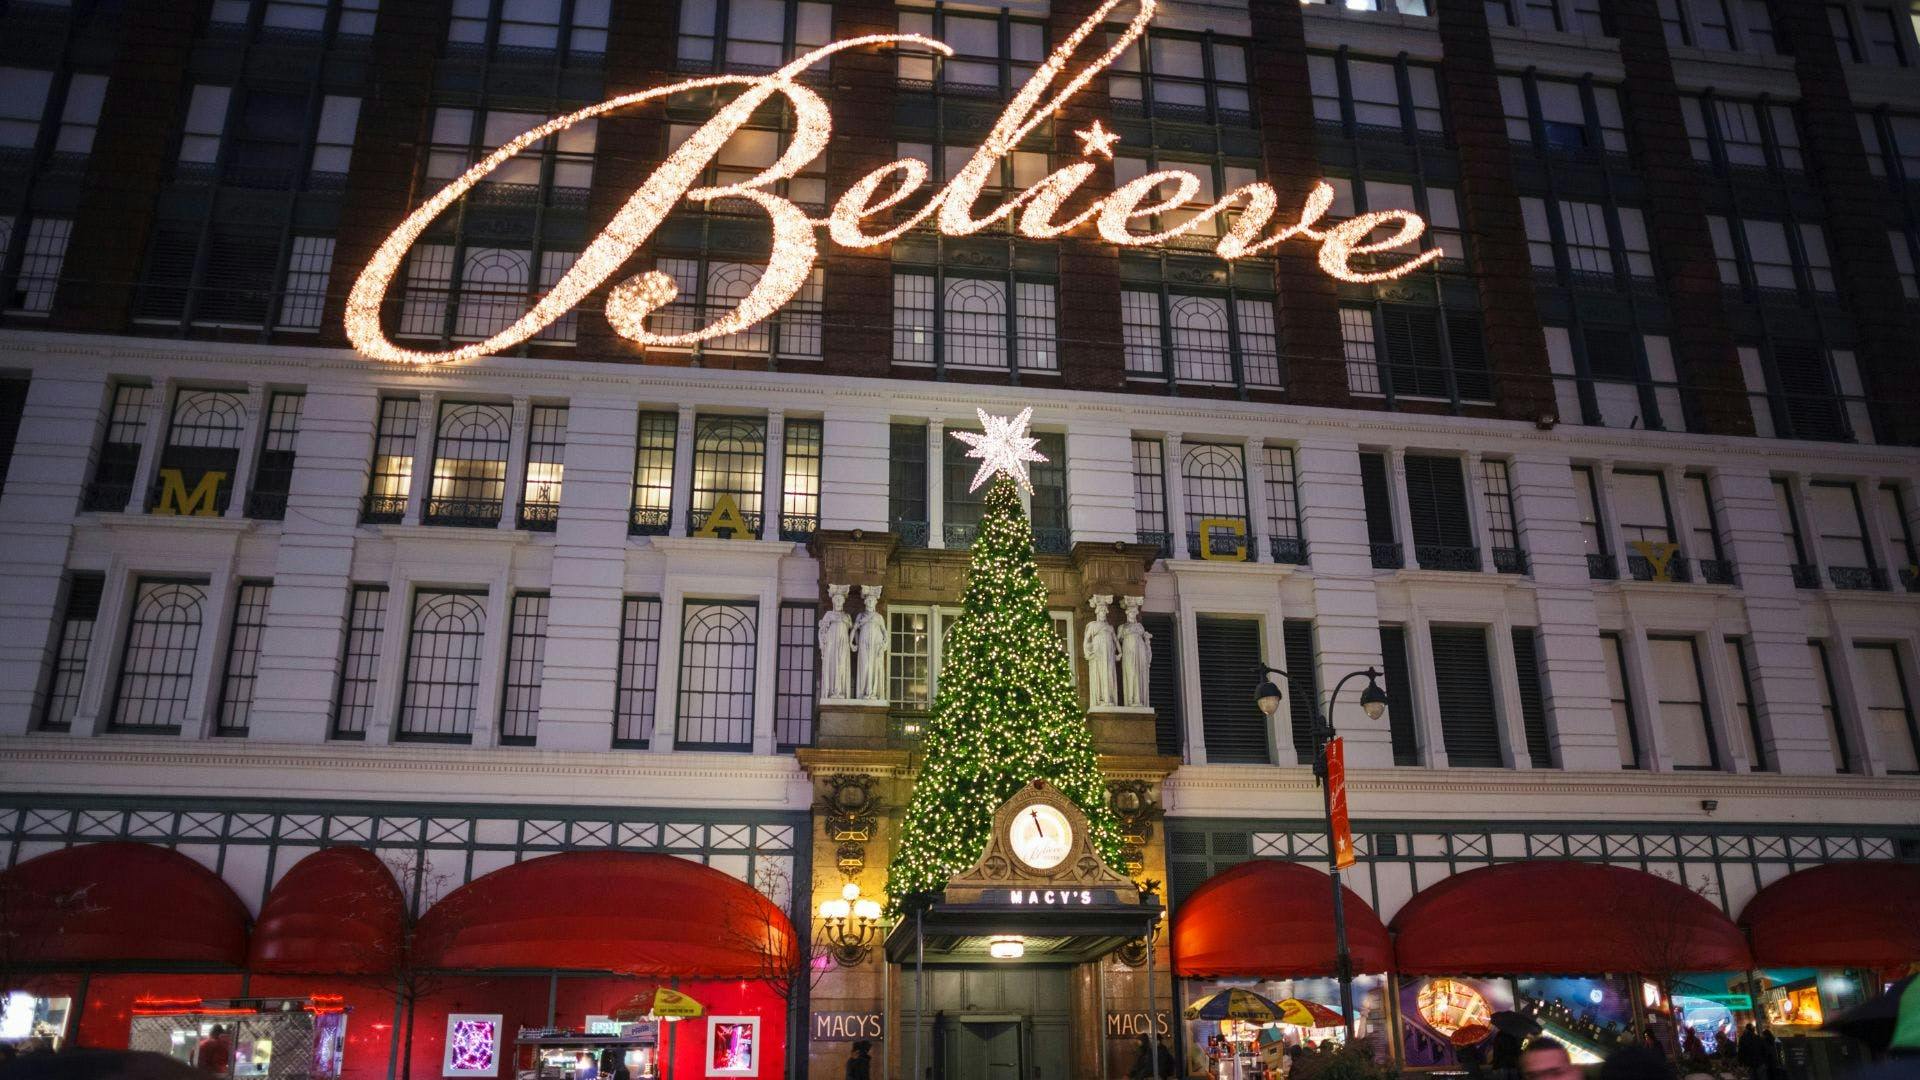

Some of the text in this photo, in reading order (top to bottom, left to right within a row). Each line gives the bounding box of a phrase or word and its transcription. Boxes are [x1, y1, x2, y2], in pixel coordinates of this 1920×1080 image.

[344, 0, 1444, 365] Believe
[152, 468, 226, 517] M
[695, 493, 755, 540] A
[1200, 519, 1246, 562] C
[1010, 889, 1092, 905] MACY'S
